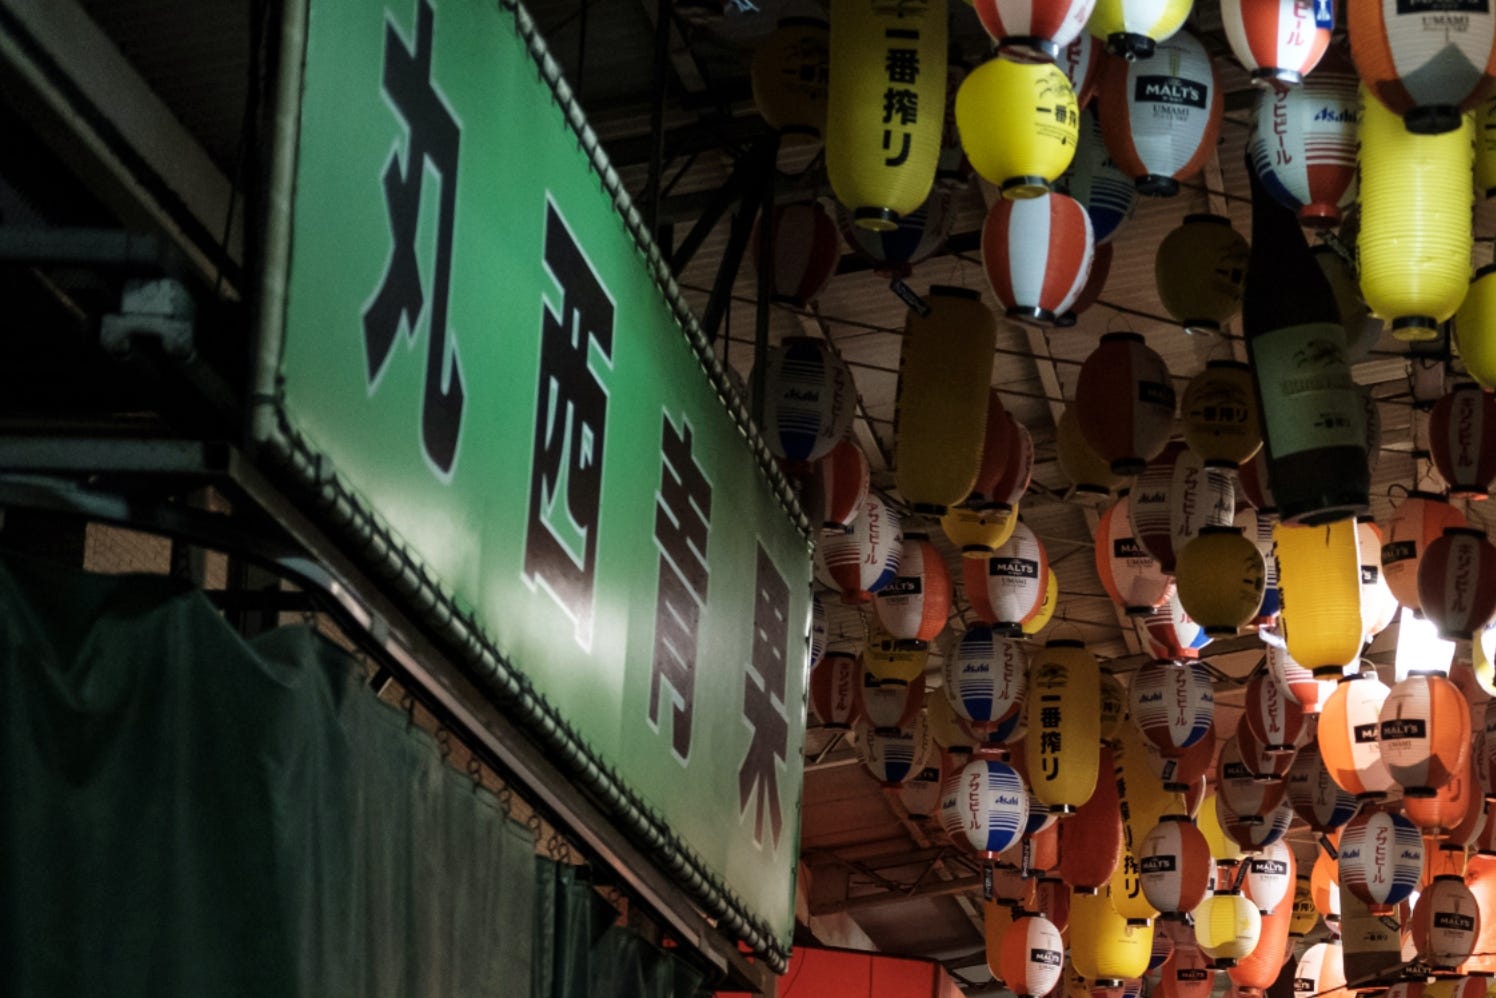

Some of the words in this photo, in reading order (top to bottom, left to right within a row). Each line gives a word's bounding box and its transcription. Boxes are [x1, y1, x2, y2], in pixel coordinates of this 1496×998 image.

[884, 28, 920, 166] 一番搾り
[1036, 106, 1078, 128] 一番搾
[1145, 84, 1201, 103] MALT'S
[1273, 84, 1292, 165] サヒビール
[1191, 407, 1248, 423] 一番搾り
[1179, 466, 1200, 537] アサヒビール
[865, 503, 879, 565] アサヒビール
[997, 563, 1034, 575] MALT'S
[1175, 670, 1187, 726] アサヒビール
[1267, 680, 1280, 733] キリンビール
[1041, 695, 1062, 780] 一番搾り
[969, 774, 981, 830] アサヒビール
[1256, 861, 1285, 872] MALT'S
[1372, 826, 1388, 884] アサヒビール
